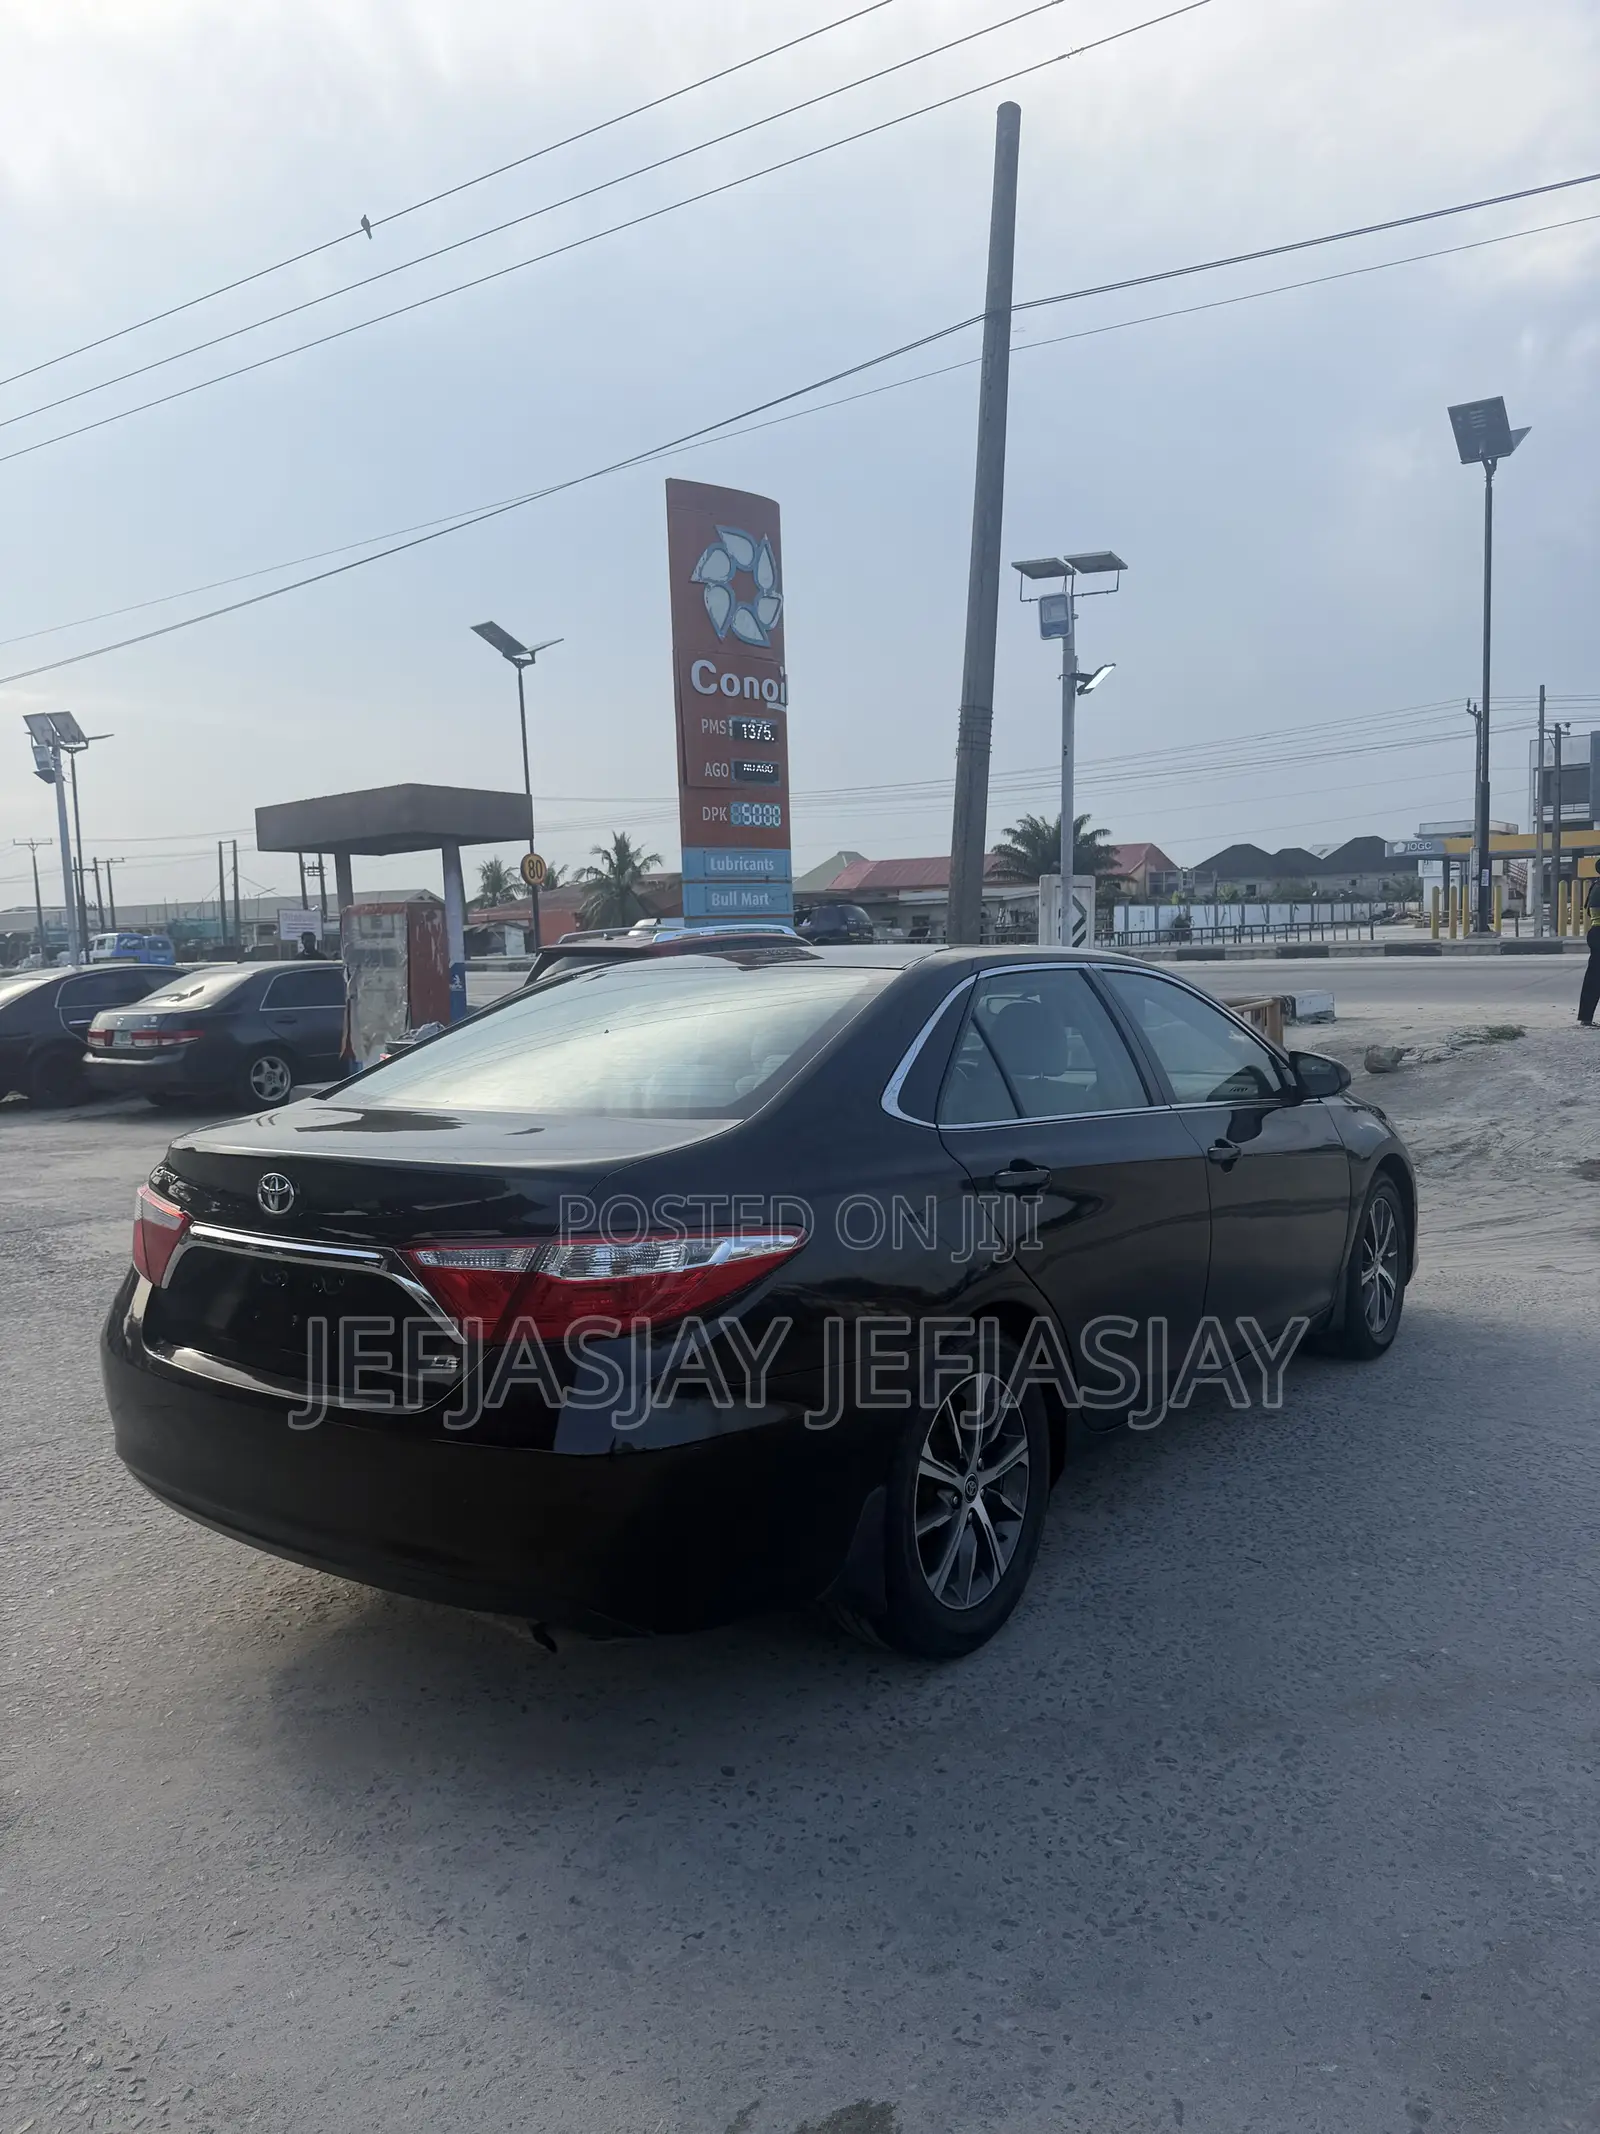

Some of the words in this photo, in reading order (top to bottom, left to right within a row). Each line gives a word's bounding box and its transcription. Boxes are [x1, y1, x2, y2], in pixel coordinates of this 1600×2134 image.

[701, 719, 726, 735] PMS
[704, 762, 729, 778] AGO
[702, 806, 728, 822] DPK
[1407, 842, 1431, 851] IOGC
[528, 859, 542, 879] 80
[710, 856, 774, 871] Lubricants
[712, 891, 737, 906] Bull
[742, 892, 769, 906] Mart
